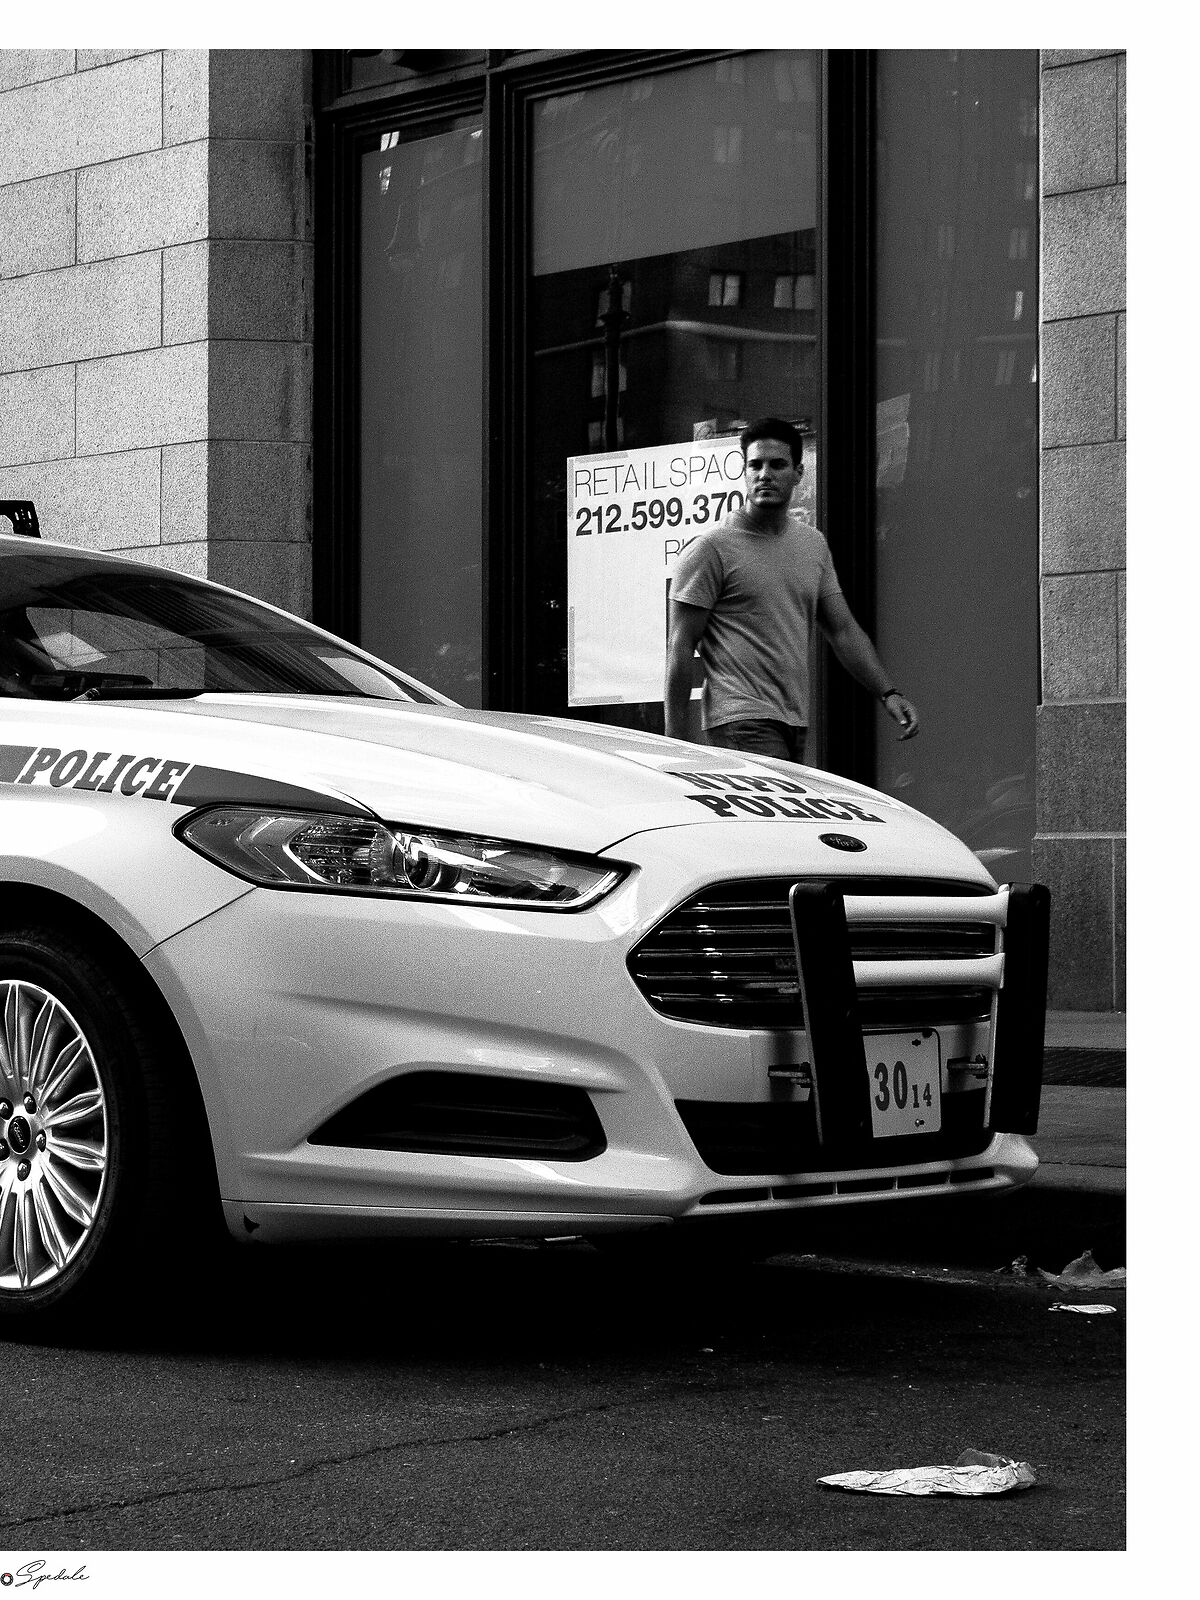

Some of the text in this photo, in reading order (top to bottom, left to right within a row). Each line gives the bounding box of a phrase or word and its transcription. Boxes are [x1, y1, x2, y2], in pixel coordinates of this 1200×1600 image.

[669, 450, 746, 487] SPAC
[575, 490, 750, 537] 212.599.370
[18, 747, 191, 802] POLICE
[663, 771, 807, 794] NYPD
[684, 794, 887, 824] POLICE
[874, 1060, 932, 1111] 30 14
